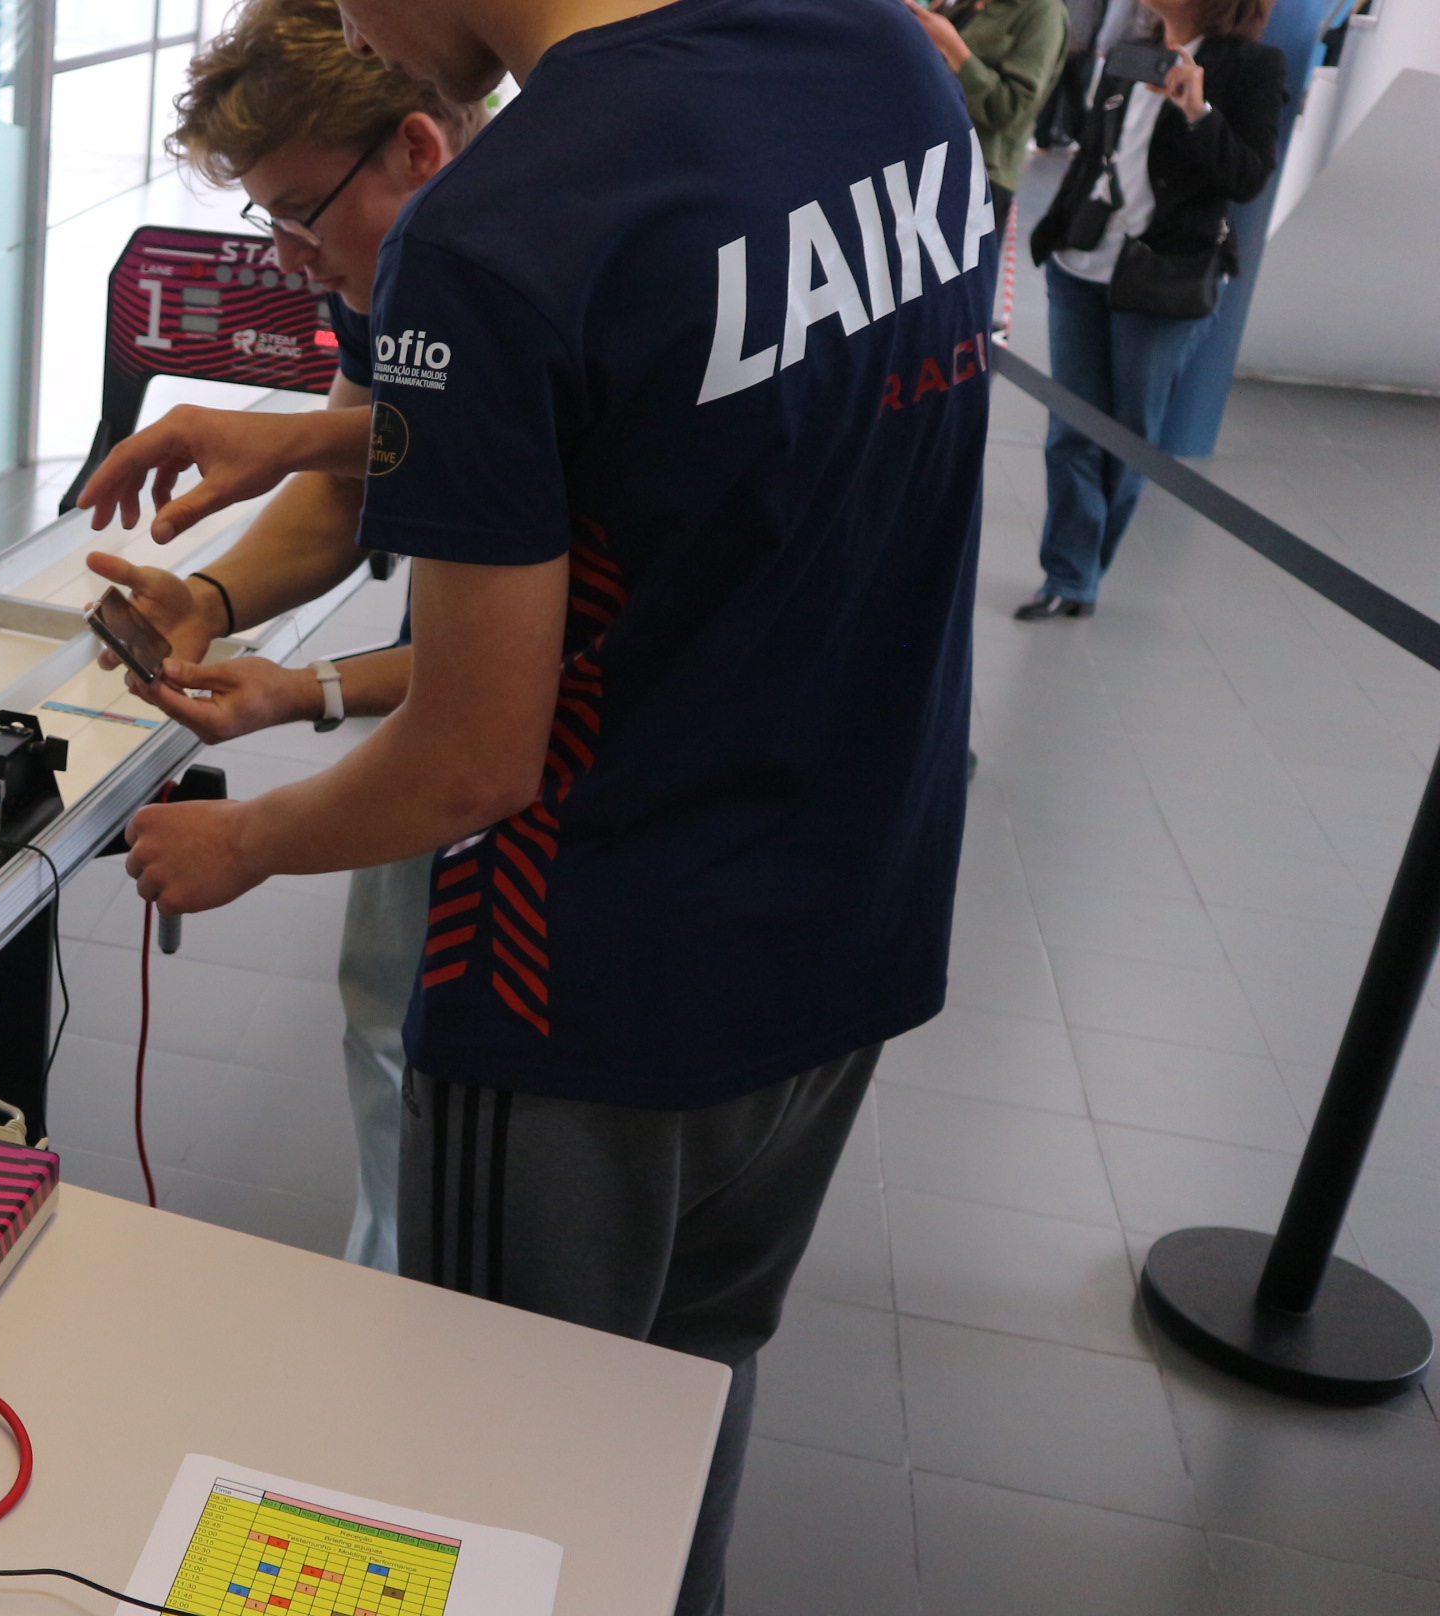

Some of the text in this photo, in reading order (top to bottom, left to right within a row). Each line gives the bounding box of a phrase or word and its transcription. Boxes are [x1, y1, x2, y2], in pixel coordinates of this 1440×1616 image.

[140, 264, 175, 276] LANE
[696, 127, 996, 406] LAIKA
[134, 278, 173, 349] 1
[259, 332, 298, 346] STEM
[254, 346, 302, 358] RACING
[375, 329, 452, 370] ofio
[411, 368, 421, 378] DE
[420, 370, 448, 382] MOLDES
[877, 329, 990, 420] RACI
[395, 375, 446, 391] MANUFACTURING
[214, 1486, 232, 1495] Time
[210, 1494, 232, 1503] 08:30
[207, 1503, 228, 1512] 09:00
[204, 1511, 224, 1520] 09:20
[200, 1519, 221, 1528] 09:45
[197, 1528, 217, 1537] 10:00
[340, 1530, 372, 1543] Receção
[194, 1536, 214, 1545] 10:15
[324, 1536, 383, 1554] Briefing equipas
[190, 1544, 211, 1554] 10:30
[287, 1534, 332, 1551] Testemunho
[338, 1548, 367, 1561] Molding
[369, 1556, 417, 1573] Performance
[187, 1553, 208, 1563] 10:45
[183, 1562, 204, 1572] 11:00
[180, 1571, 200, 1581] 11:15
[176, 1580, 197, 1590] 11:30
[172, 1589, 193, 1599] 11:45
[168, 1599, 189, 1608] 12:00
